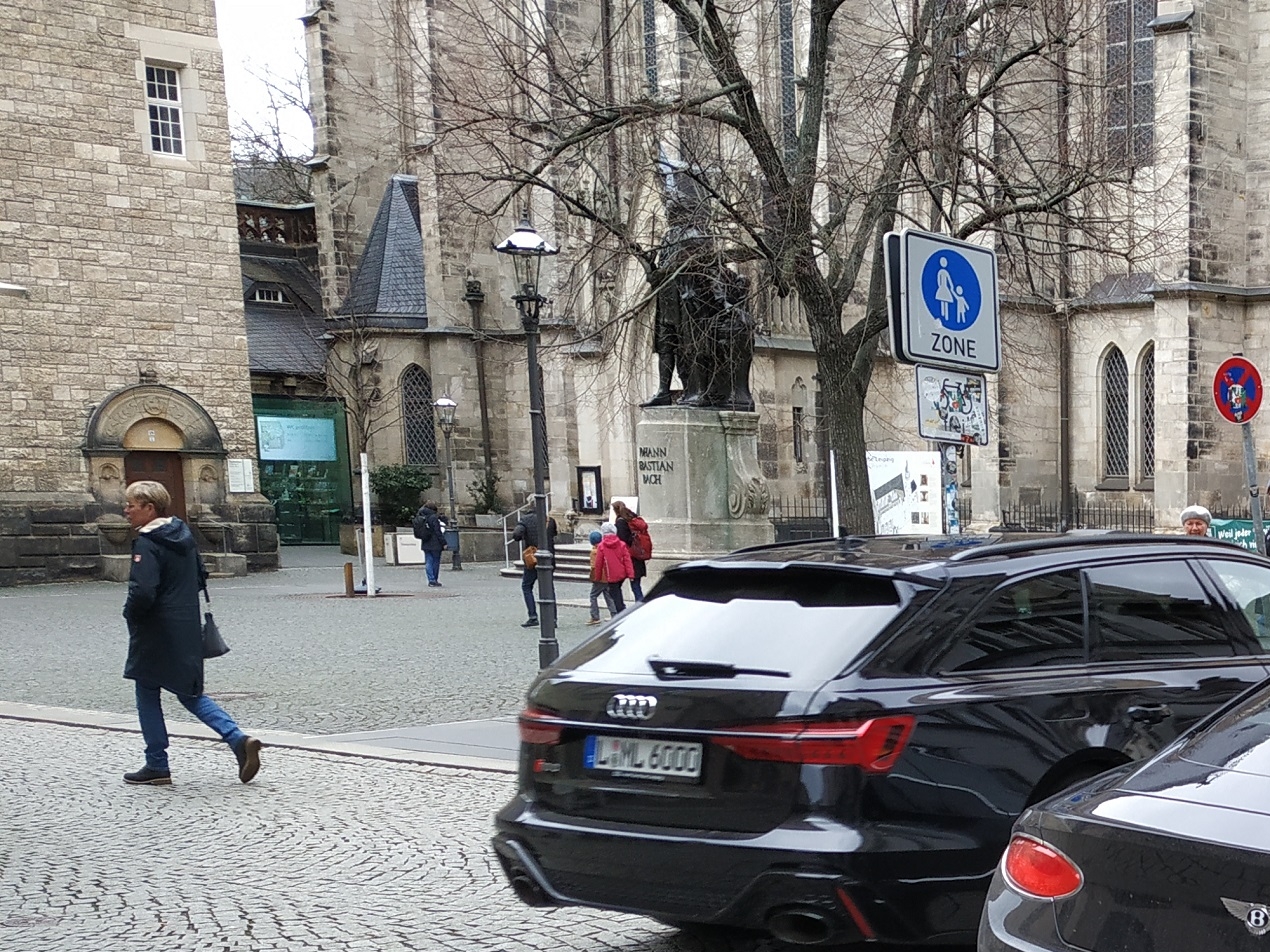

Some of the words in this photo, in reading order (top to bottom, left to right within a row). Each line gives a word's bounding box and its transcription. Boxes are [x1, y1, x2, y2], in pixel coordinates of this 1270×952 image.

[931, 332, 977, 358] ZONE
[1218, 528, 1234, 540] Weil
[1234, 528, 1252, 541] jeder
